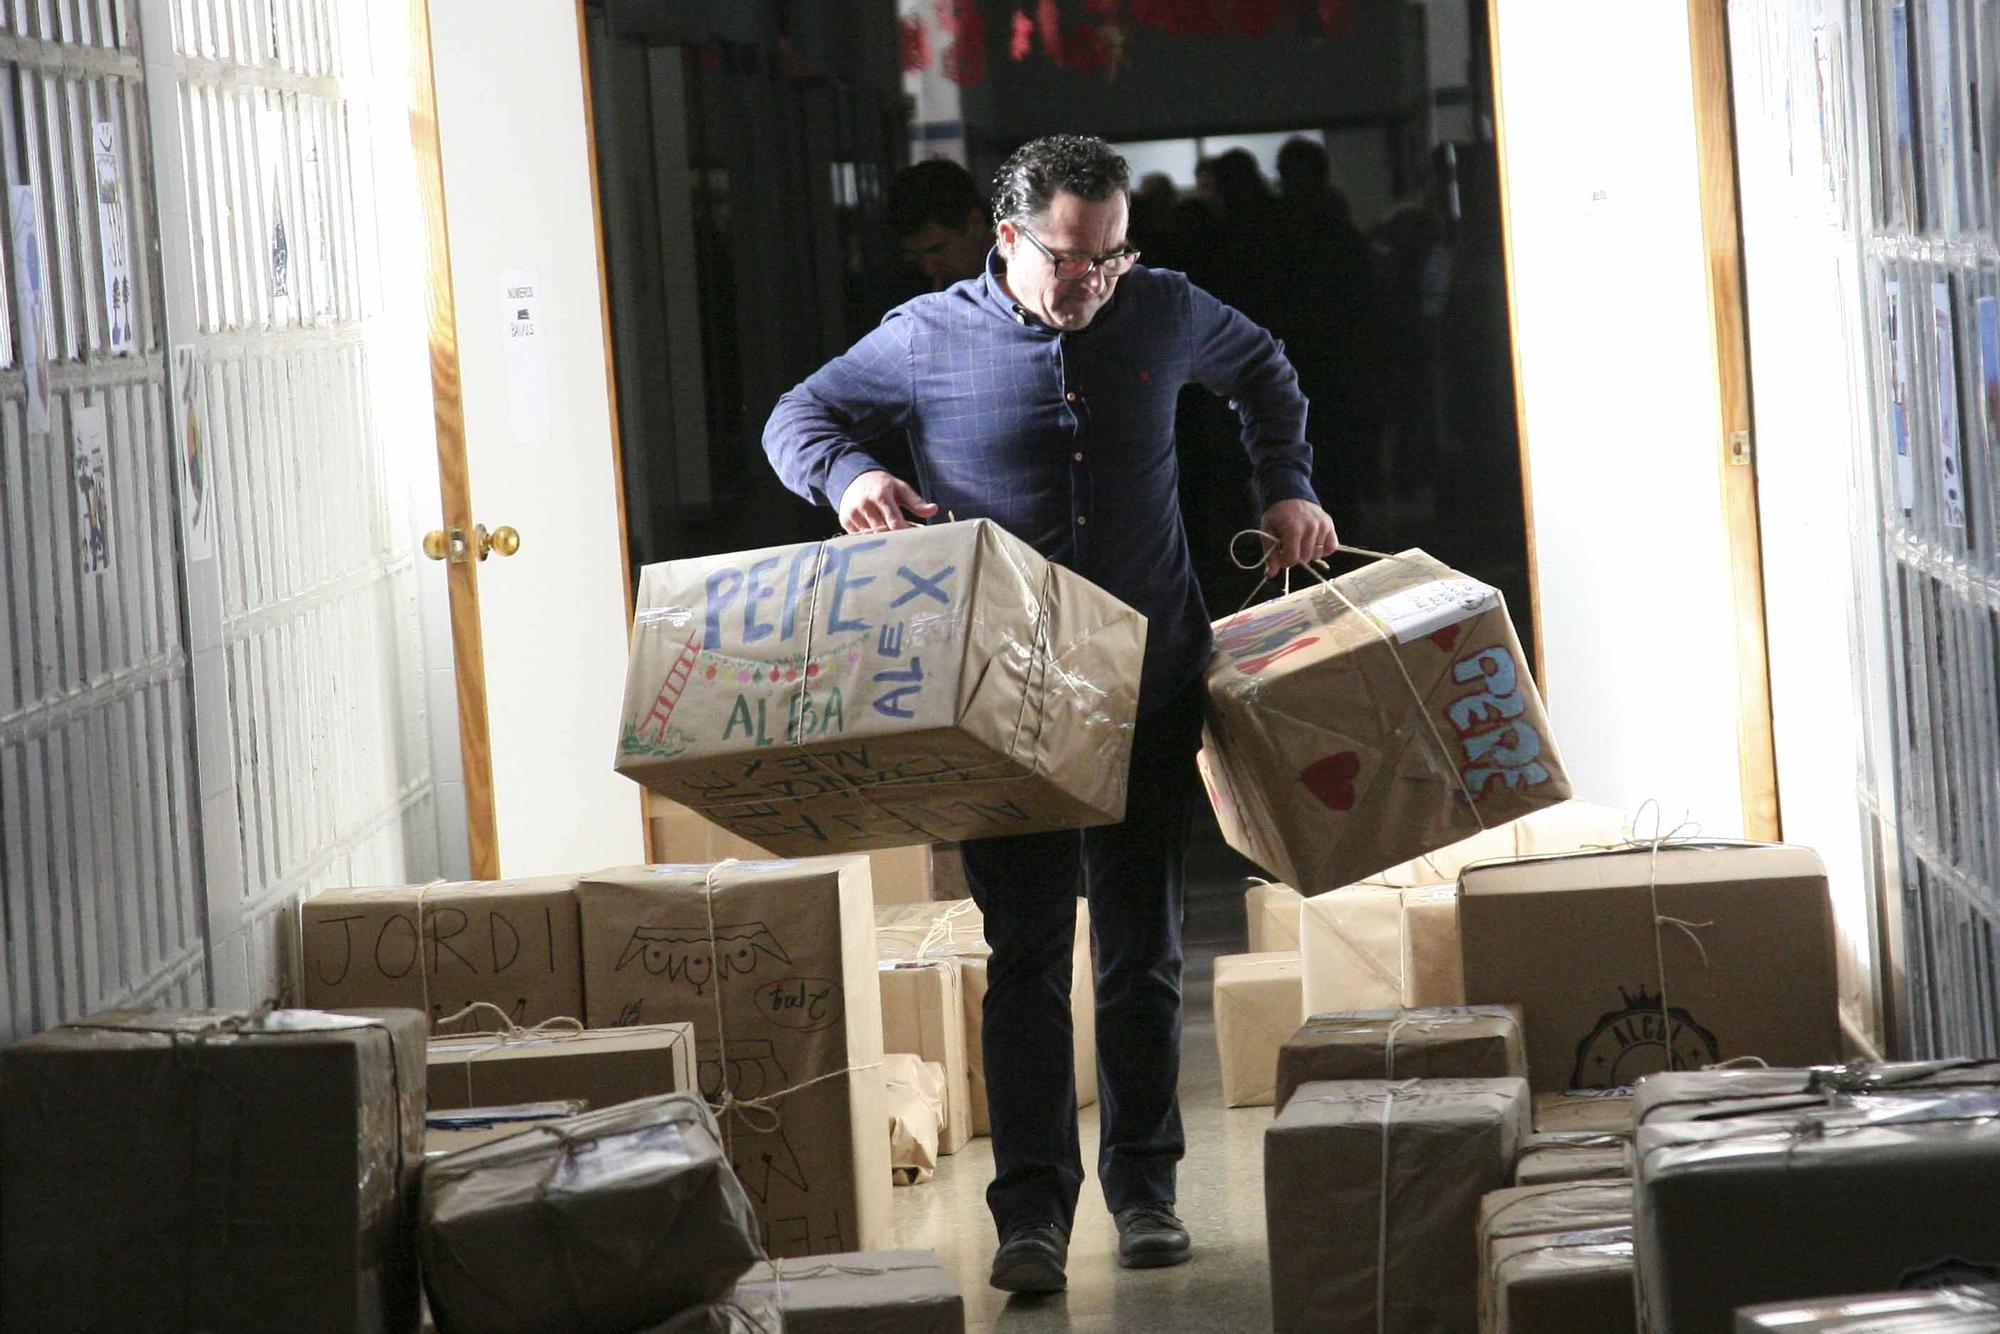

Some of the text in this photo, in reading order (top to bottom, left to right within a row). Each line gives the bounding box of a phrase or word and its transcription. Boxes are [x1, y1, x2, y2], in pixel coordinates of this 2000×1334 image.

[703, 538, 887, 650] PEPE
[873, 564, 956, 720] ALEX
[722, 686, 845, 746] ALBA
[1444, 645, 1551, 801] PERE
[316, 906, 556, 986] JORDI
